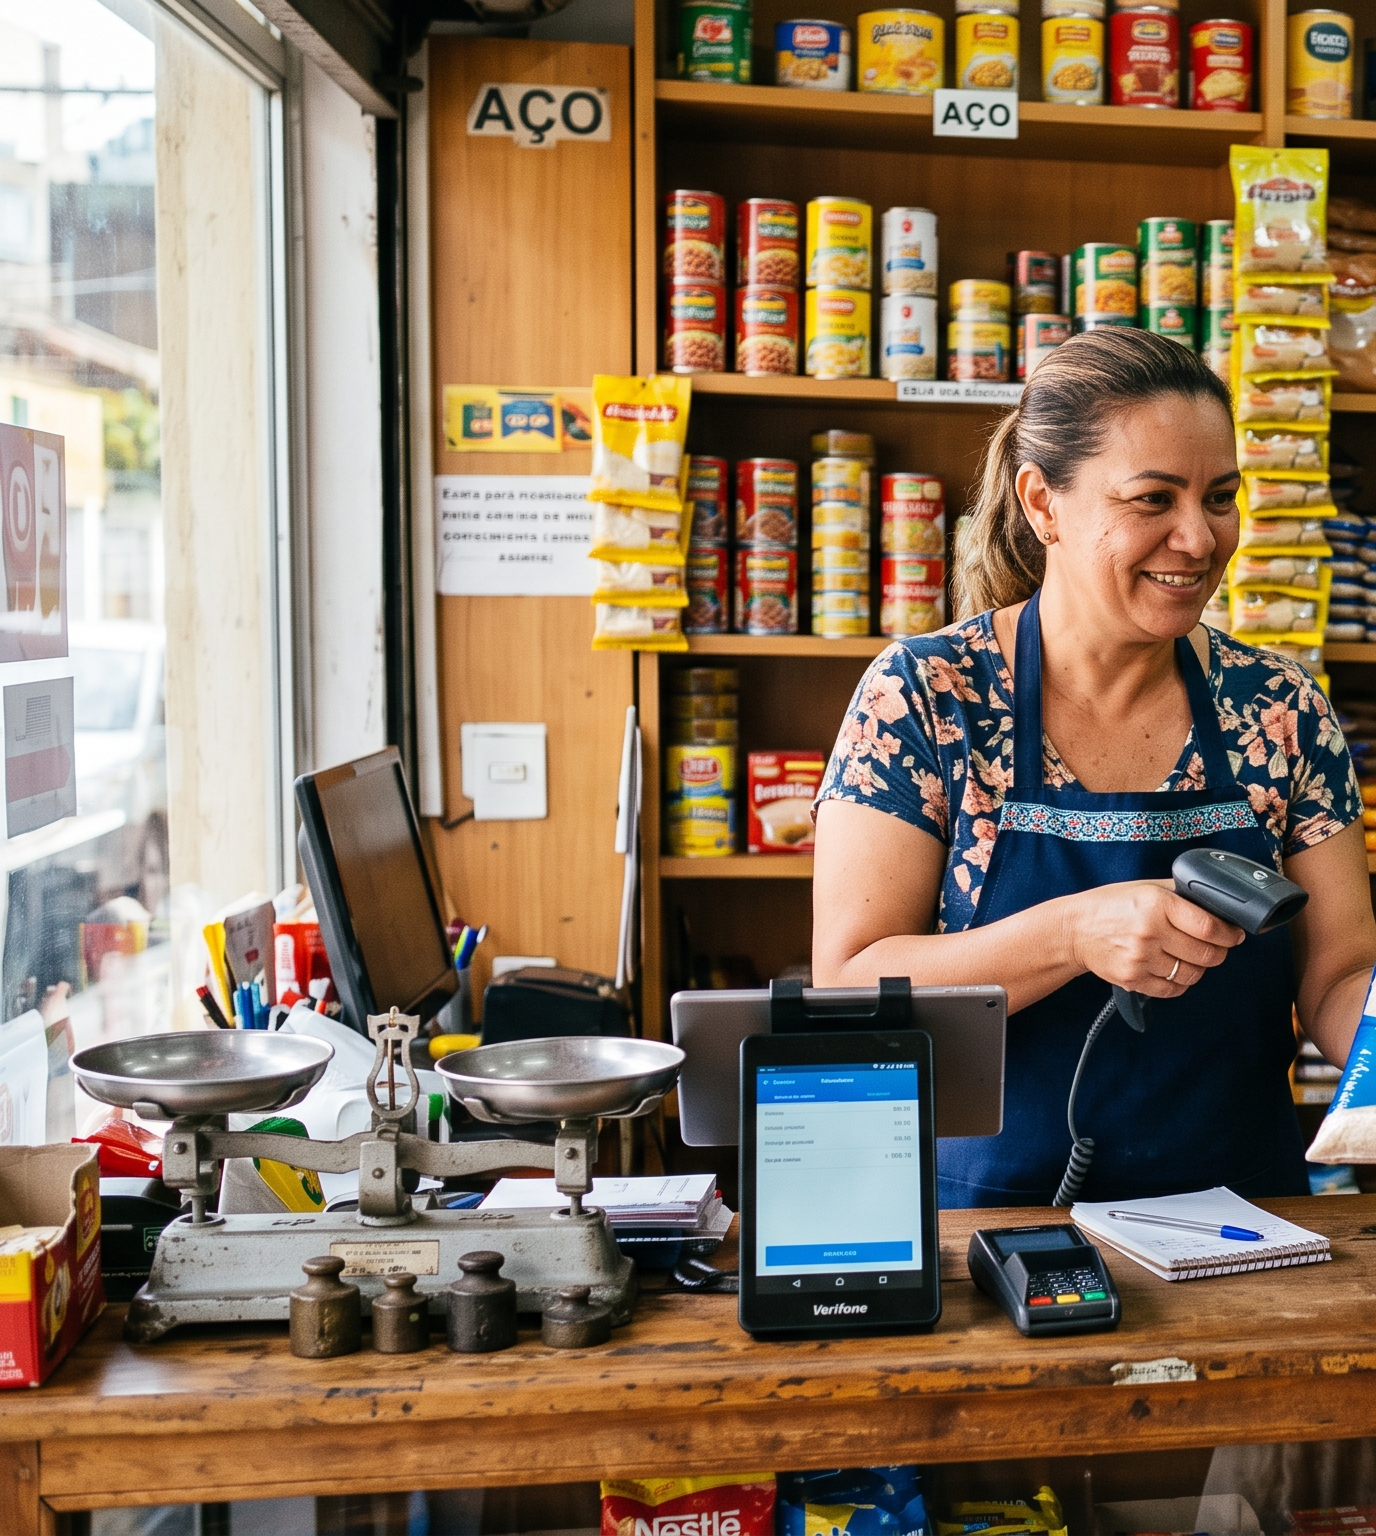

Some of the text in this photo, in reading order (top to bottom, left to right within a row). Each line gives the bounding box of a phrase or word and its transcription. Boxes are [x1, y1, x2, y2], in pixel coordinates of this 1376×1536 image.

[473, 87, 603, 143] AÇO
[941, 102, 1011, 131] AÇO
[812, 1303, 868, 1317] Verifone
